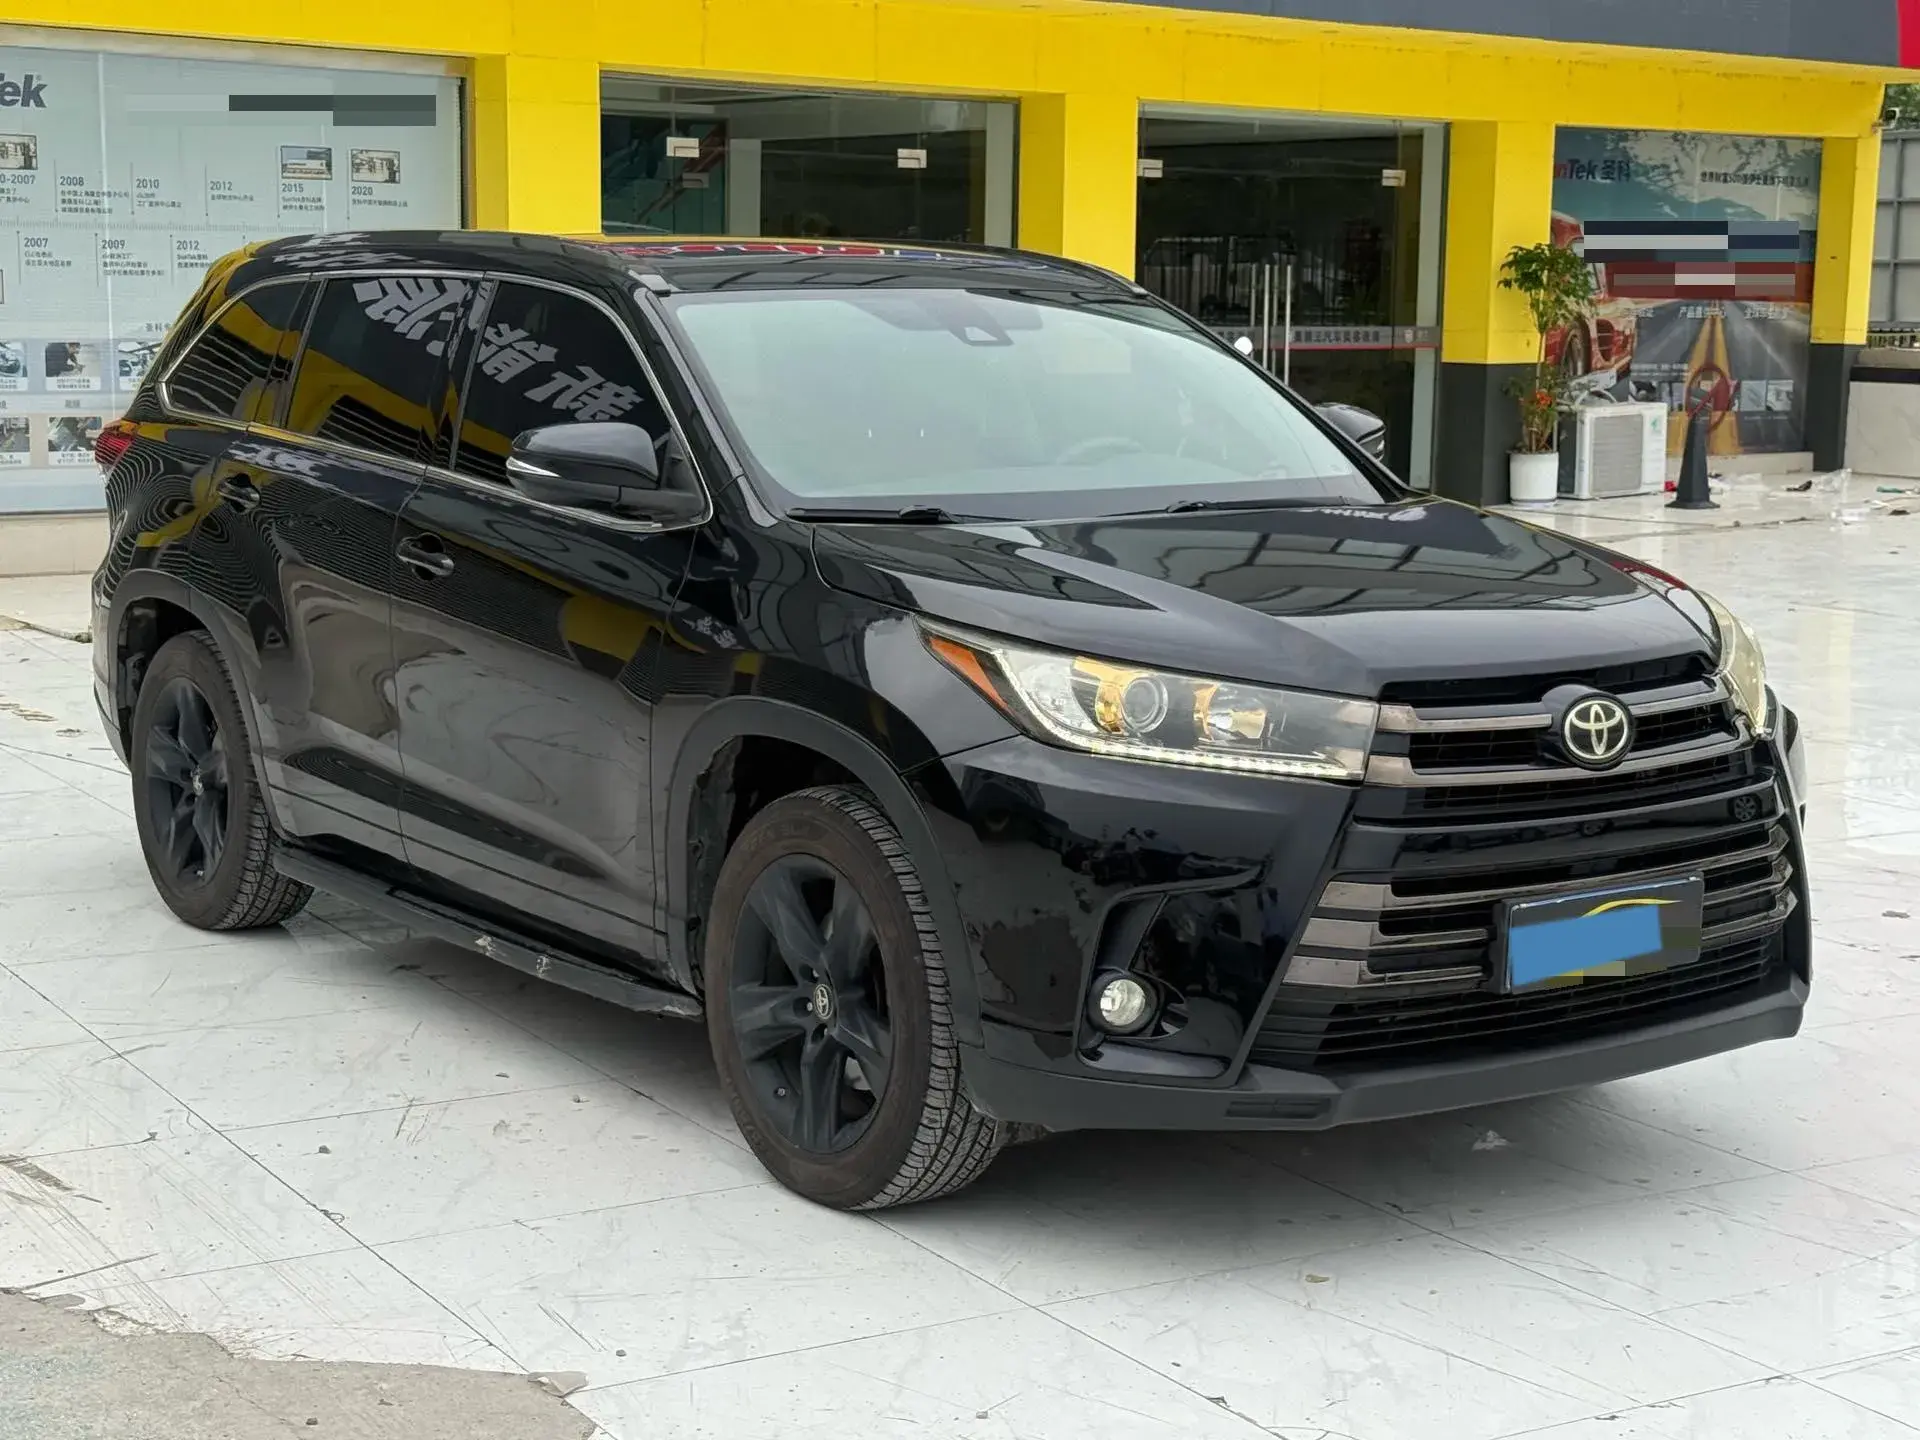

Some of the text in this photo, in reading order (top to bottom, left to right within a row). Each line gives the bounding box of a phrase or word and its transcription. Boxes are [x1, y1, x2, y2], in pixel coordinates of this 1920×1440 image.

[60, 176, 84, 186] 2008
[136, 178, 160, 189] 2010
[210, 181, 233, 191] 2012
[282, 183, 305, 193] 2015
[351, 186, 374, 196] 2020
[24, 237, 48, 248] 2007
[102, 239, 126, 249] 2009
[176, 240, 199, 250] 2012
